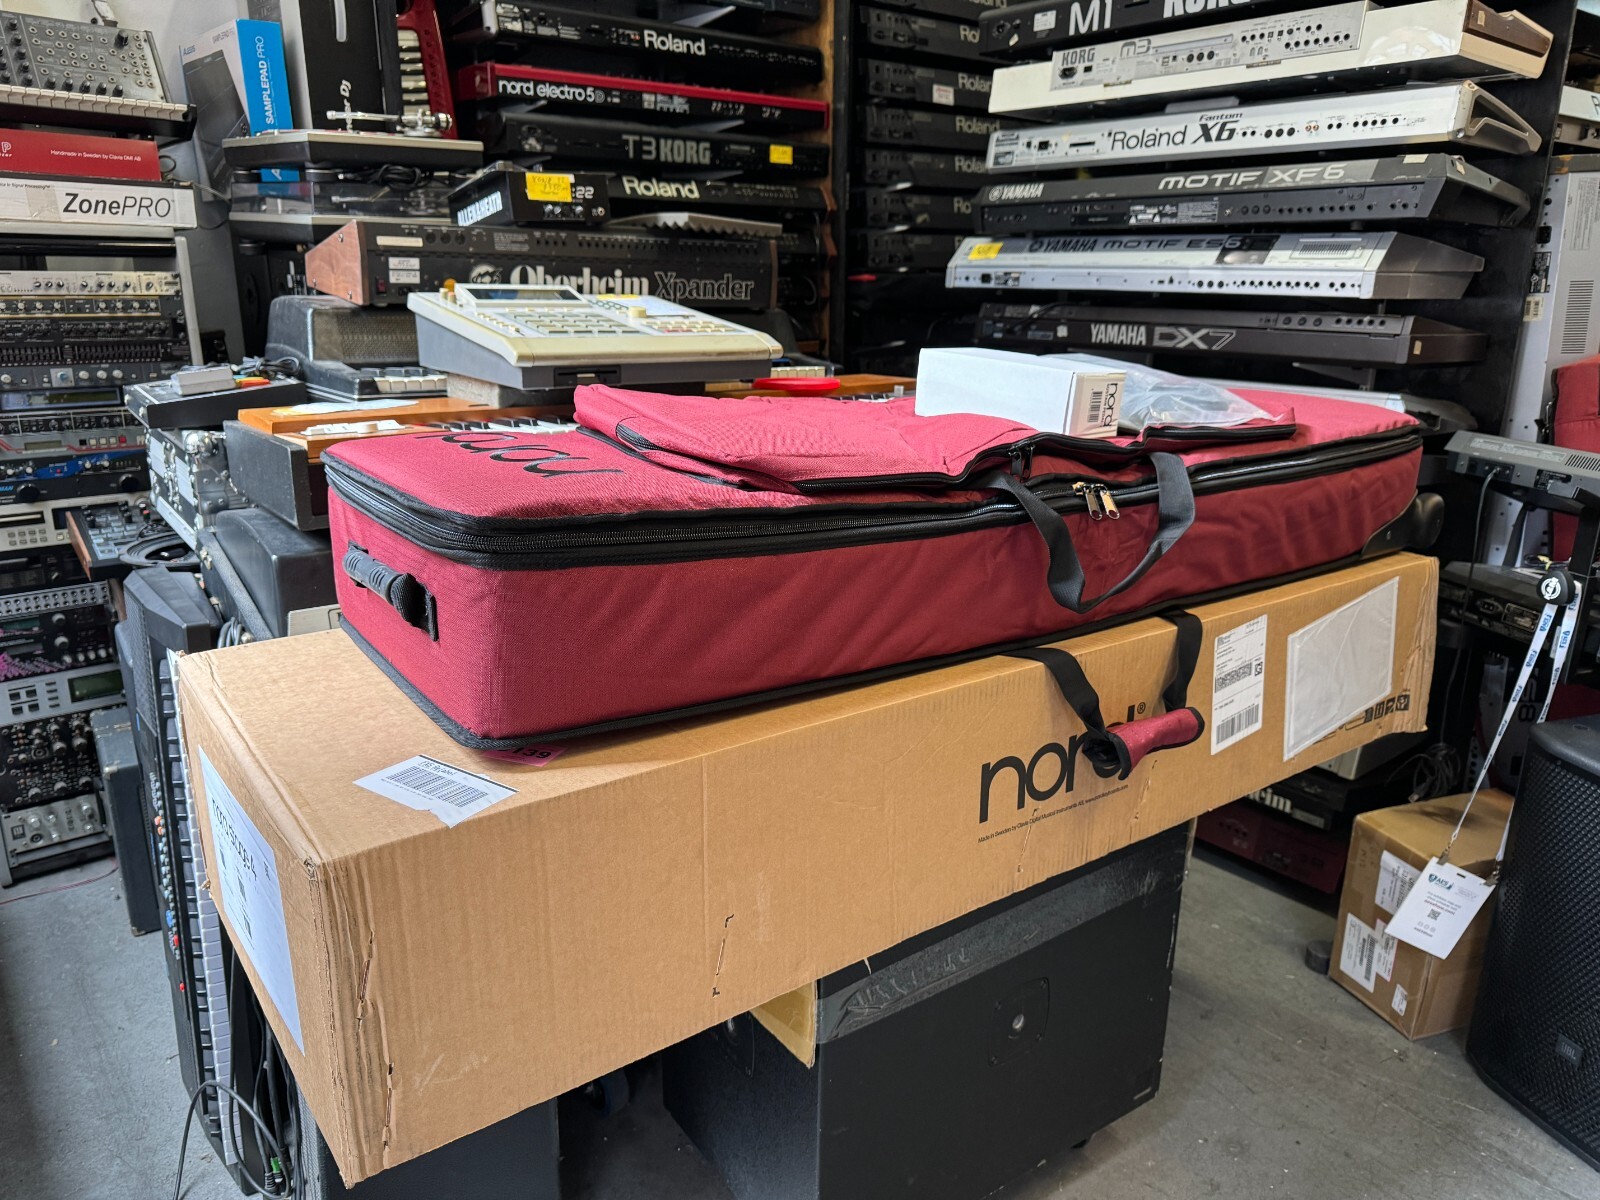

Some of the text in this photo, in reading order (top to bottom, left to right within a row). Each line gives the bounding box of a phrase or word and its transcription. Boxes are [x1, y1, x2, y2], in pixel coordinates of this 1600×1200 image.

[643, 29, 706, 57] Roland
[1061, 48, 1096, 67] KORG
[255, 36, 275, 125] SAMPLEPAD PRO
[339, 79, 352, 98] DJ
[498, 80, 534, 96] nord
[1199, 112, 1243, 122] Fantom
[1111, 119, 1240, 151] Roland X6
[51, 149, 77, 157] Handmade
[659, 138, 711, 165] KORG
[621, 175, 700, 199] Roland
[1158, 163, 1348, 190] MOTIF XF6
[1001, 183, 1045, 200] YAMAHA
[63, 192, 172, 218] ZonePRO
[1042, 237, 1098, 253] YAMAHA
[1102, 238, 1184, 250] MOTIF
[510, 264, 755, 302] Oberheim Xpander
[1090, 323, 1237, 350] YAMAHA DX7
[1103, 383, 1118, 427] nord
